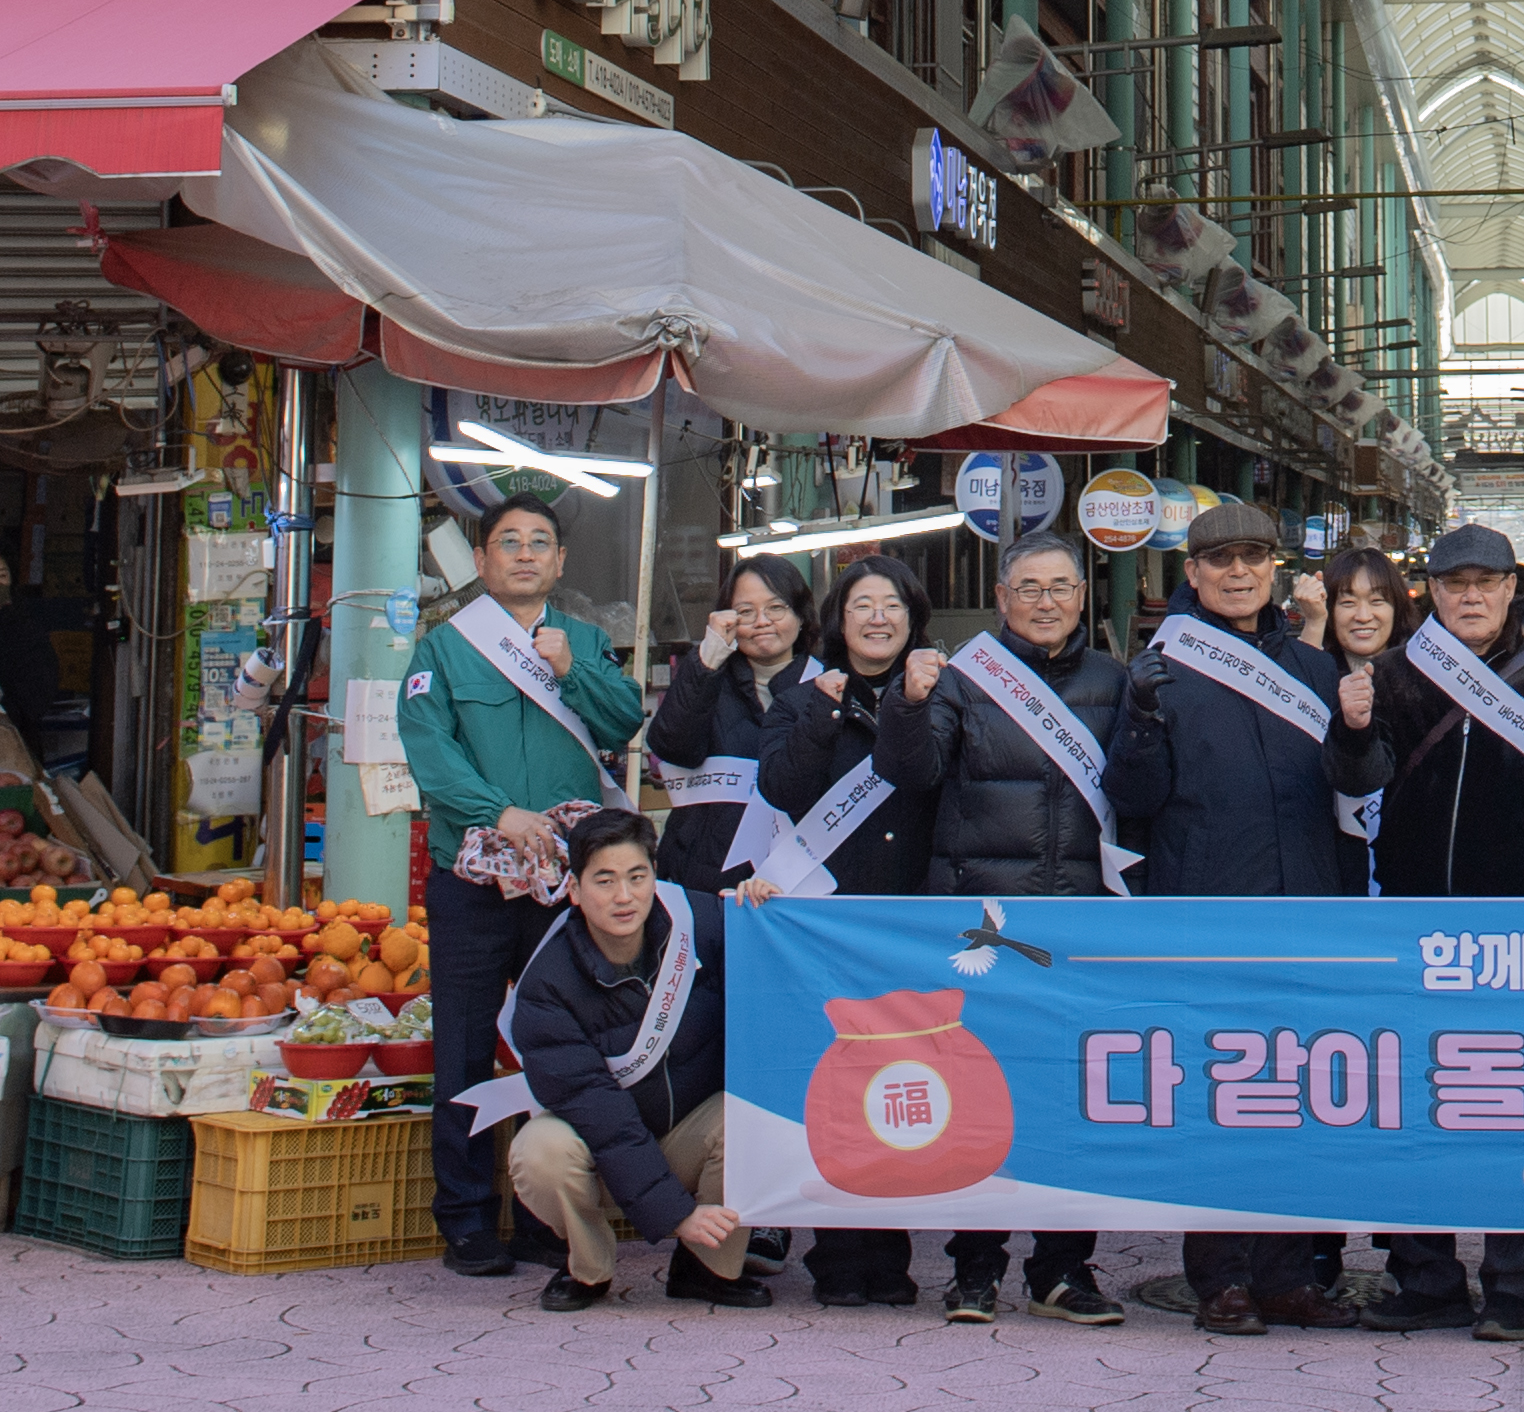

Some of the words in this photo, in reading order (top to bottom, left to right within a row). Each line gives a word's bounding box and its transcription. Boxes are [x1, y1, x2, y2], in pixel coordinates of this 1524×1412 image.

[509, 475, 558, 494] 418-4024
[969, 478, 1047, 499] 미남육점
[1160, 505, 1194, 522] 이네
[1178, 631, 1257, 676] 물가안정에
[970, 647, 1046, 716] 전통시장을
[653, 931, 689, 1032] 전통시장을
[1079, 1028, 1186, 1130] 다
[1204, 1028, 1403, 1131] 같이
[882, 1081, 934, 1129] 福
